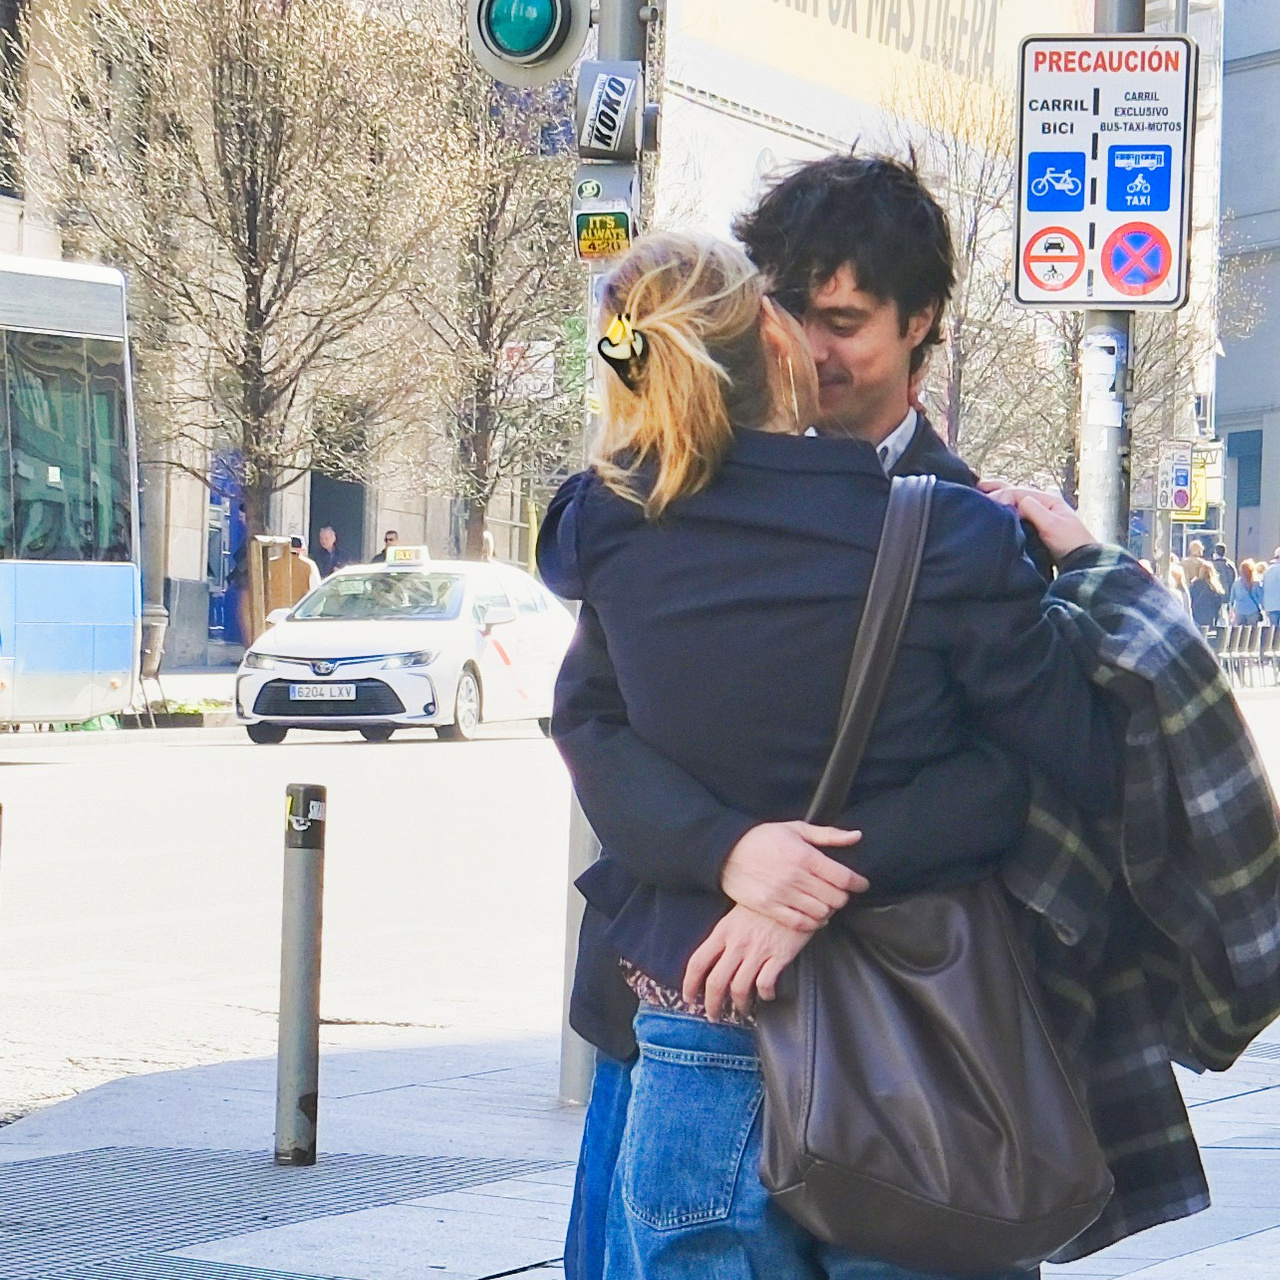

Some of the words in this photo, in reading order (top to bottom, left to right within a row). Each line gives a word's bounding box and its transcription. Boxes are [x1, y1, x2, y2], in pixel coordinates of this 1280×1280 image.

[1033, 45, 1180, 73] PRECAUCIÓN
[1124, 91, 1160, 102] CARRIL
[1028, 99, 1089, 112] CARRIL
[1114, 106, 1169, 117] EXCLUSIVO
[593, 76, 627, 148] KOKO
[1041, 122, 1075, 135] BICI
[1125, 195, 1151, 207] TAXI
[580, 228, 627, 240] ALWAYS
[297, 686, 325, 698] 6204
[329, 686, 352, 698] LXV
